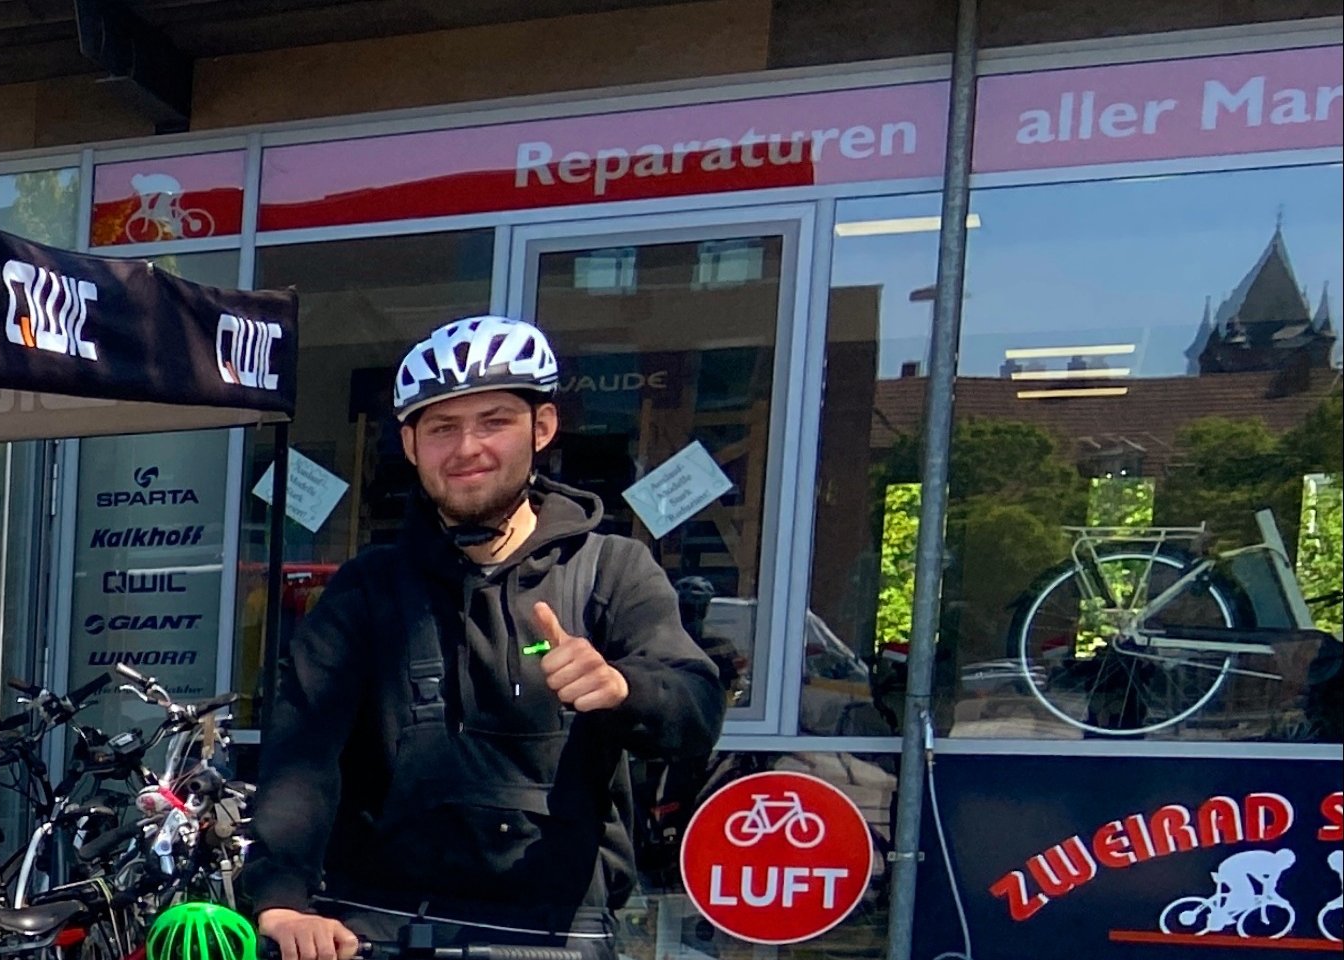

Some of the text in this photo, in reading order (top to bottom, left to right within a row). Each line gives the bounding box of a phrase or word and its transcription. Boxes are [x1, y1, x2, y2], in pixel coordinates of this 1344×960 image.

[1015, 91, 1179, 144] aller
[514, 119, 917, 197] Reparaturen
[2, 258, 99, 362] QWIC
[216, 313, 283, 391] QWIC
[96, 489, 200, 508] SPARTA
[89, 525, 205, 549] Kalkhoff
[102, 569, 187, 594] QWIC
[108, 614, 203, 631] GIANT
[87, 650, 198, 667] WINORA
[988, 791, 1295, 922] ZWEIRAD
[710, 864, 849, 910] LUFT
